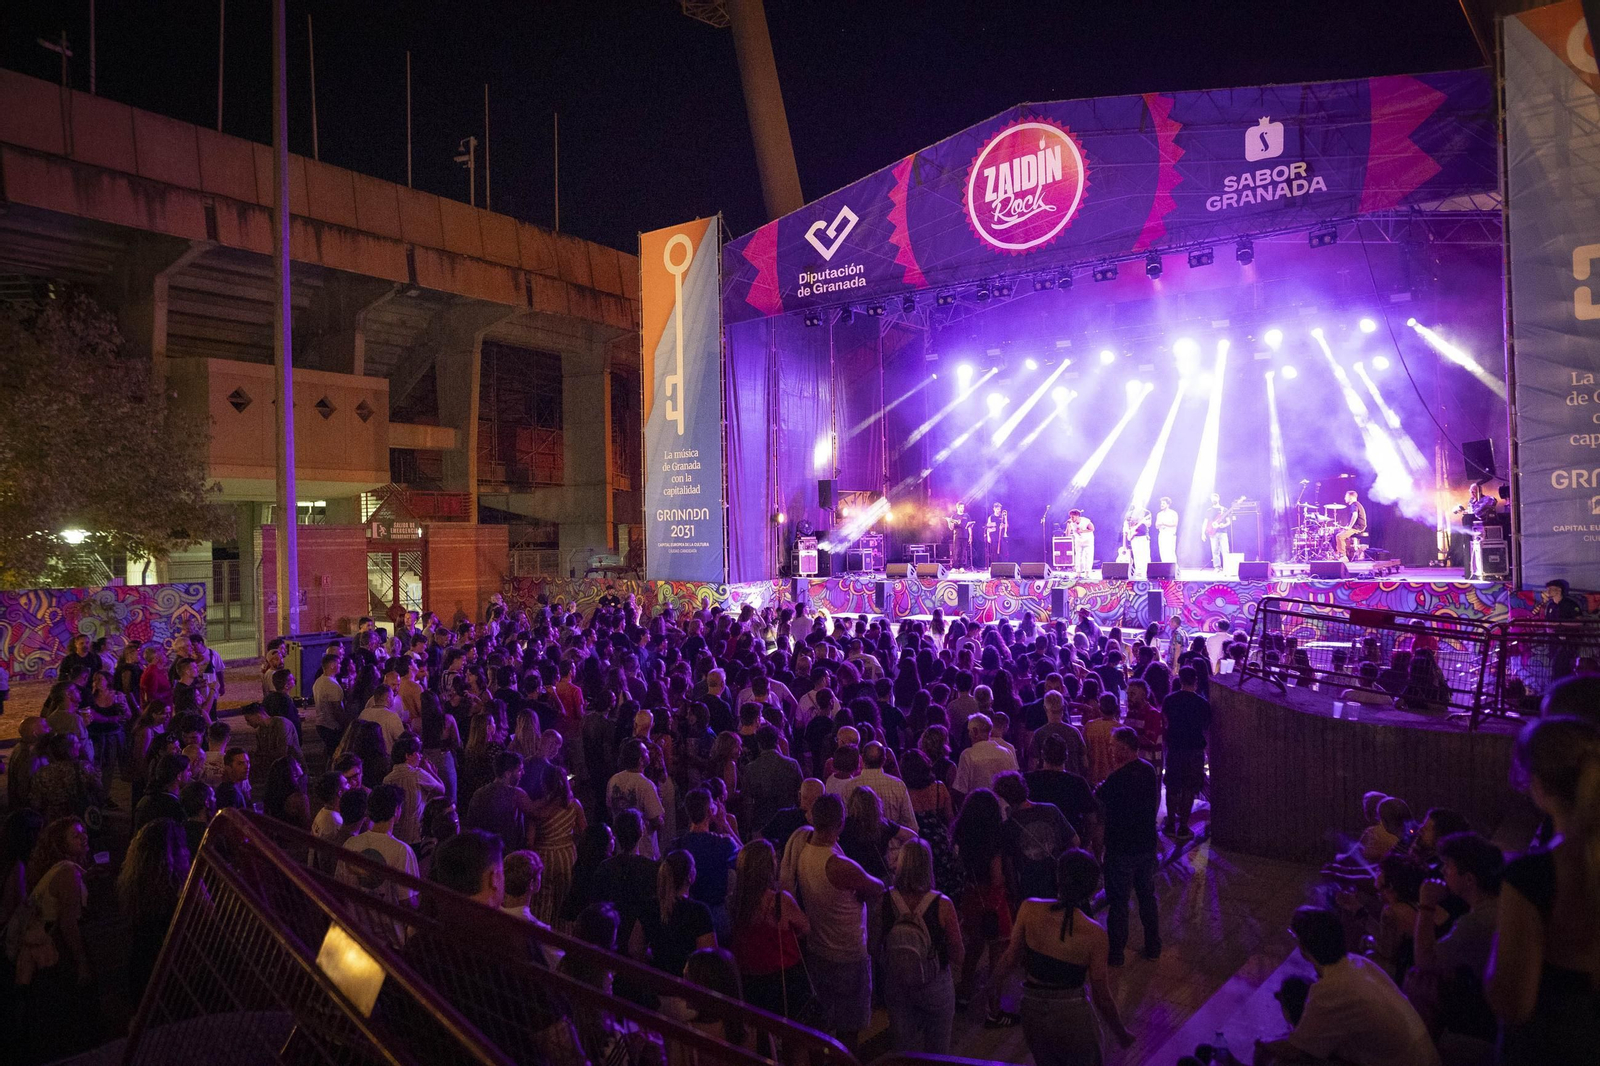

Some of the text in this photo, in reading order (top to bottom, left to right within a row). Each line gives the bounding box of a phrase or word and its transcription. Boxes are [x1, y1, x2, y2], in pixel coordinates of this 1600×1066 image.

[1223, 162, 1307, 192] SABOR
[1205, 176, 1328, 212] GRANADA
[991, 185, 1057, 229] Rock
[798, 263, 864, 284] Diputación
[797, 276, 867, 298] de Granada
[1571, 371, 1595, 386] La
[1565, 391, 1589, 406] de
[664, 448, 699, 460] La música
[662, 460, 701, 471] de Granada
[671, 473, 692, 483] con la
[663, 484, 701, 498] capitalidad
[656, 508, 710, 521] GRANADA
[670, 525, 695, 539] 2031
[1552, 524, 1588, 532] CAPITAL
